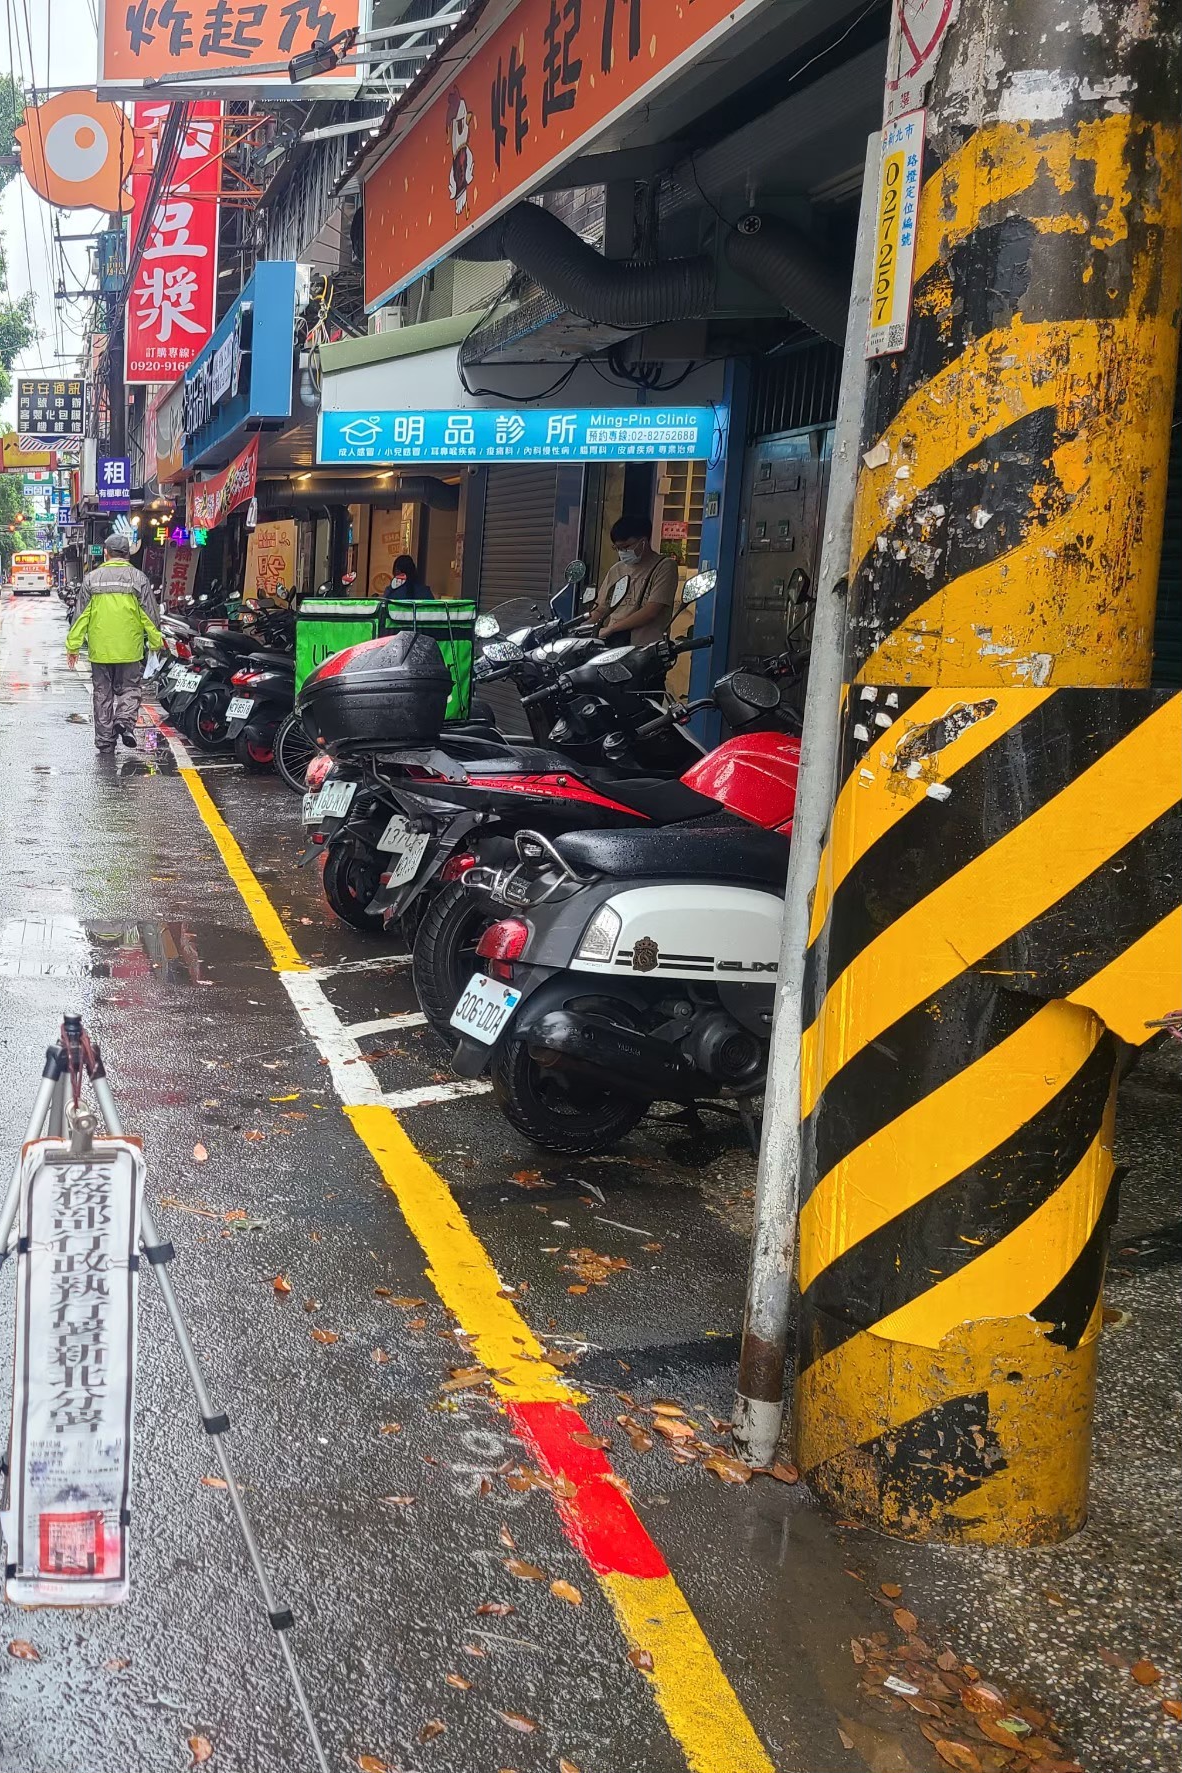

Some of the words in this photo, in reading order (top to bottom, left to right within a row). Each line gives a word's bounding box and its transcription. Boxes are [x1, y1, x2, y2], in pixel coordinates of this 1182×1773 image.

[888, 123, 915, 145] 新北市
[901, 154, 918, 247] 路燈定位編號
[875, 162, 899, 321] 027257
[22, 382, 81, 395] 安安通訊
[20, 397, 81, 408] 門號申辦
[20, 409, 81, 420] 客製化包膜
[590, 414, 651, 427] Ming-Pin
[656, 414, 697, 425] Clinic
[20, 421, 81, 432] 手機維修
[393, 415, 577, 445] 明品診所
[104, 462, 125, 484] 租
[456, 991, 506, 1036] 306-DDA
